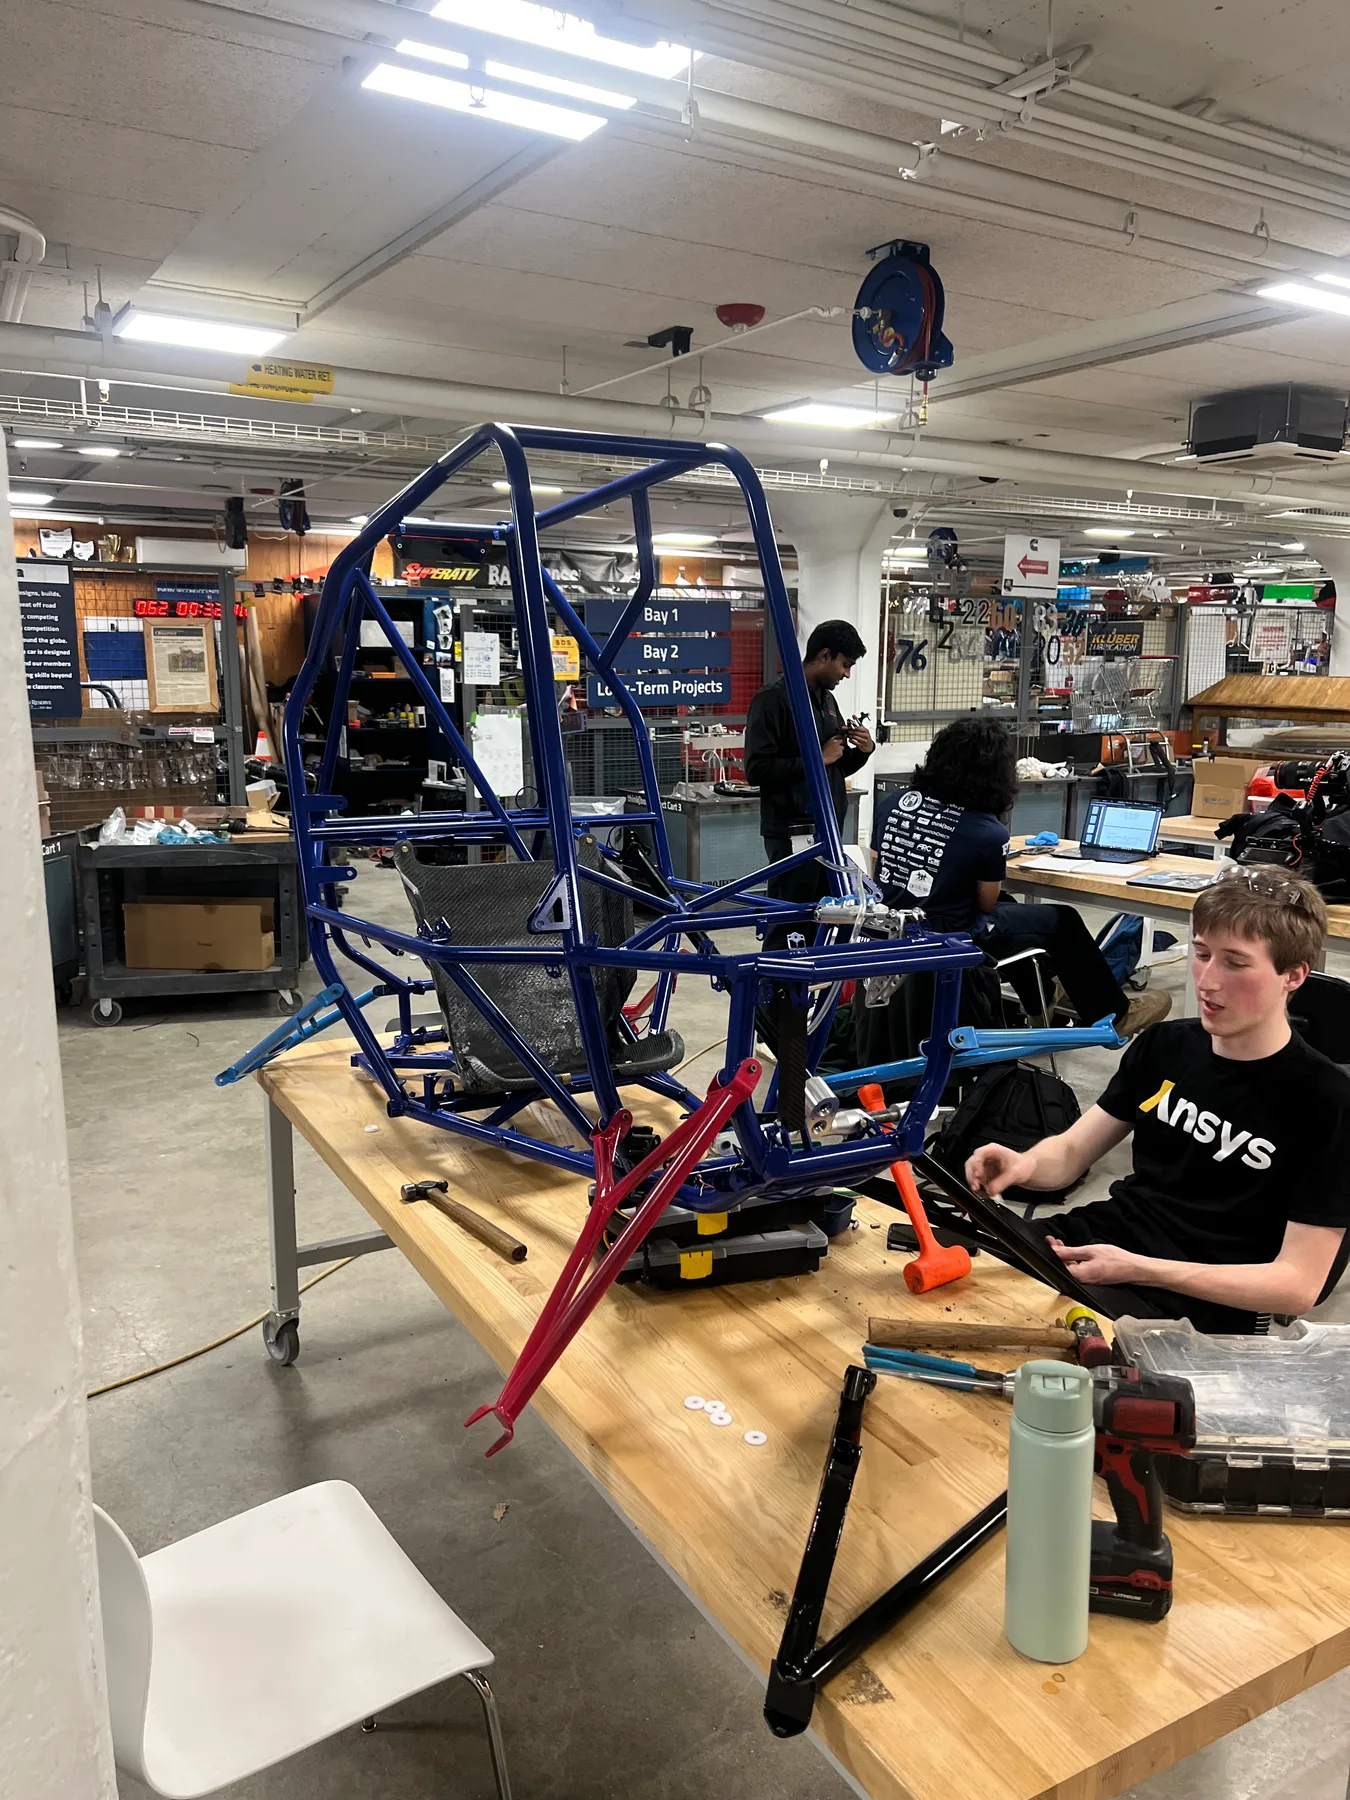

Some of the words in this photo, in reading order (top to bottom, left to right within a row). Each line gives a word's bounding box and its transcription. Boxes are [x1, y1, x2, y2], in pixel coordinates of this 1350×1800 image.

[264, 364, 293, 378] HEATING
[294, 369, 316, 381] WATER
[26, 614, 59, 622] competing
[644, 607, 668, 625] Bay
[672, 608, 679, 622] 1
[43, 649, 71, 657] designed
[643, 644, 668, 662] Bay
[670, 644, 679, 658] 2
[895, 638, 928, 674] 76
[597, 681, 669, 696] Lo-Term
[672, 679, 723, 697] Projects
[56, 841, 61, 852] 1
[1138, 1079, 1277, 1170] Ansys
